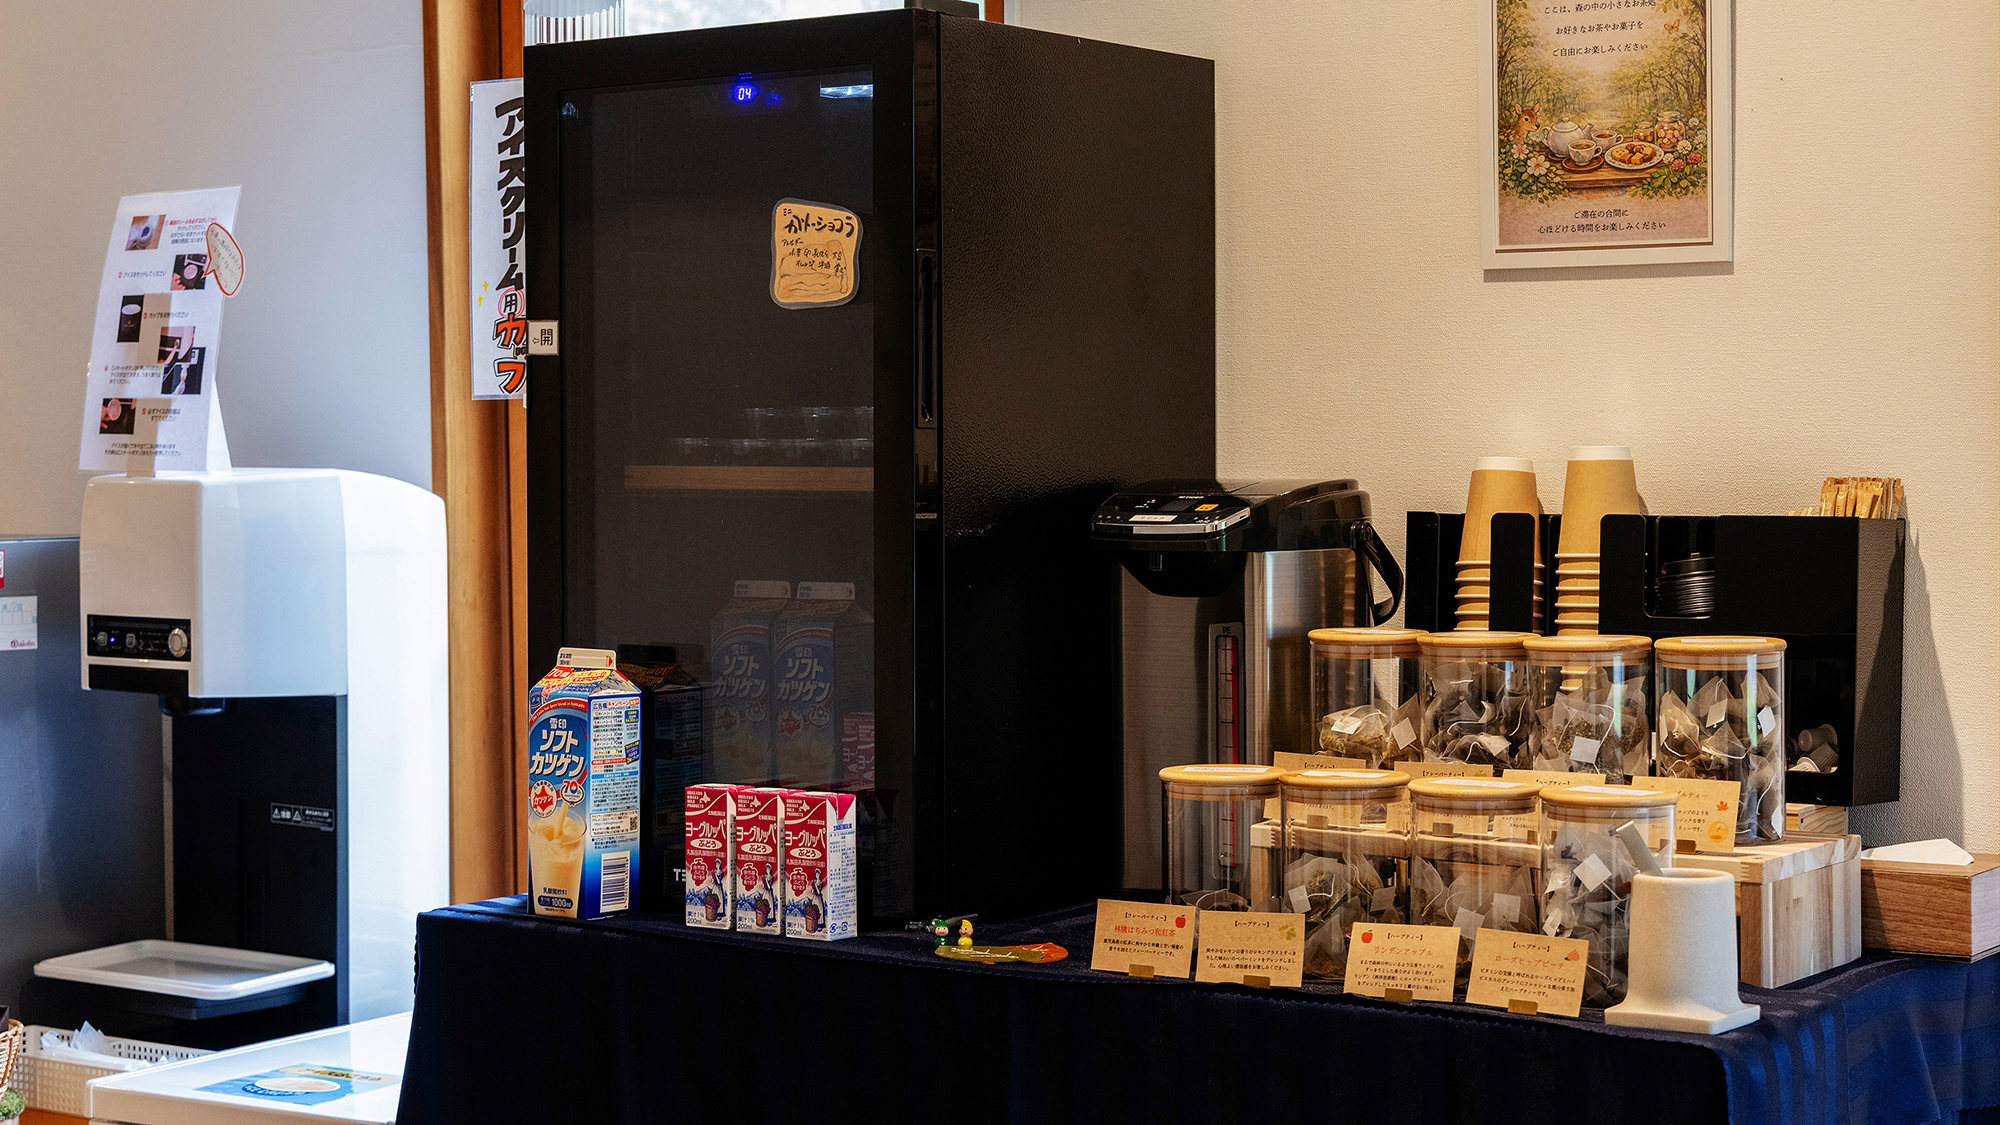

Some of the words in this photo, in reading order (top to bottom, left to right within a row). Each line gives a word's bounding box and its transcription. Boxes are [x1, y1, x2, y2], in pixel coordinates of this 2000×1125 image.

[1556, 21, 1644, 35] お好きなお茶やお菓子を
[1552, 43, 1648, 57] ご自由にお楽しみください
[738, 87, 751, 100] 04
[1573, 209, 1629, 219] ご滞在の合間に
[1537, 221, 1666, 234] 心ほどける時間をお楽しみください
[540, 328, 553, 346] 開
[723, 655, 760, 676] ソフト
[786, 658, 824, 680] ソフト
[777, 679, 830, 702] カツゲン
[549, 717, 567, 730] 雪印
[540, 729, 579, 753] ソフト
[530, 751, 585, 778] カツゲン
[686, 818, 727, 840] ヨーグルッペ
[736, 823, 777, 845] ヨーグルッペ
[698, 839, 717, 849] ぶどう
[785, 827, 827, 849] ヨーグルッペ
[748, 844, 767, 853] ぶどう
[798, 848, 817, 858] ぶどう
[551, 898, 572, 909] 1000ml
[687, 917, 702, 925] 200ml
[1125, 912, 1167, 922] 【フレーバーティー】
[737, 922, 753, 930] 200ml
[1235, 920, 1270, 928] 【ハーブティー】
[787, 928, 802, 936] 200ml
[1114, 925, 1176, 938] 林檎はちみつ和紅茶
[1387, 932, 1423, 941] 【ハーブティー】
[1109, 946, 1175, 957] 香りを加えたフレーバーティーです。
[1374, 946, 1433, 957] リンデンアップル
[1512, 941, 1550, 953] 【ハーブティー】
[1494, 955, 1565, 970] ローズヒップピーチ
[1480, 967, 1576, 984] ビタミンの宝庫と呼ばれるローズヒップとハイ
[1499, 986, 1549, 998] えたハーブティーです。
